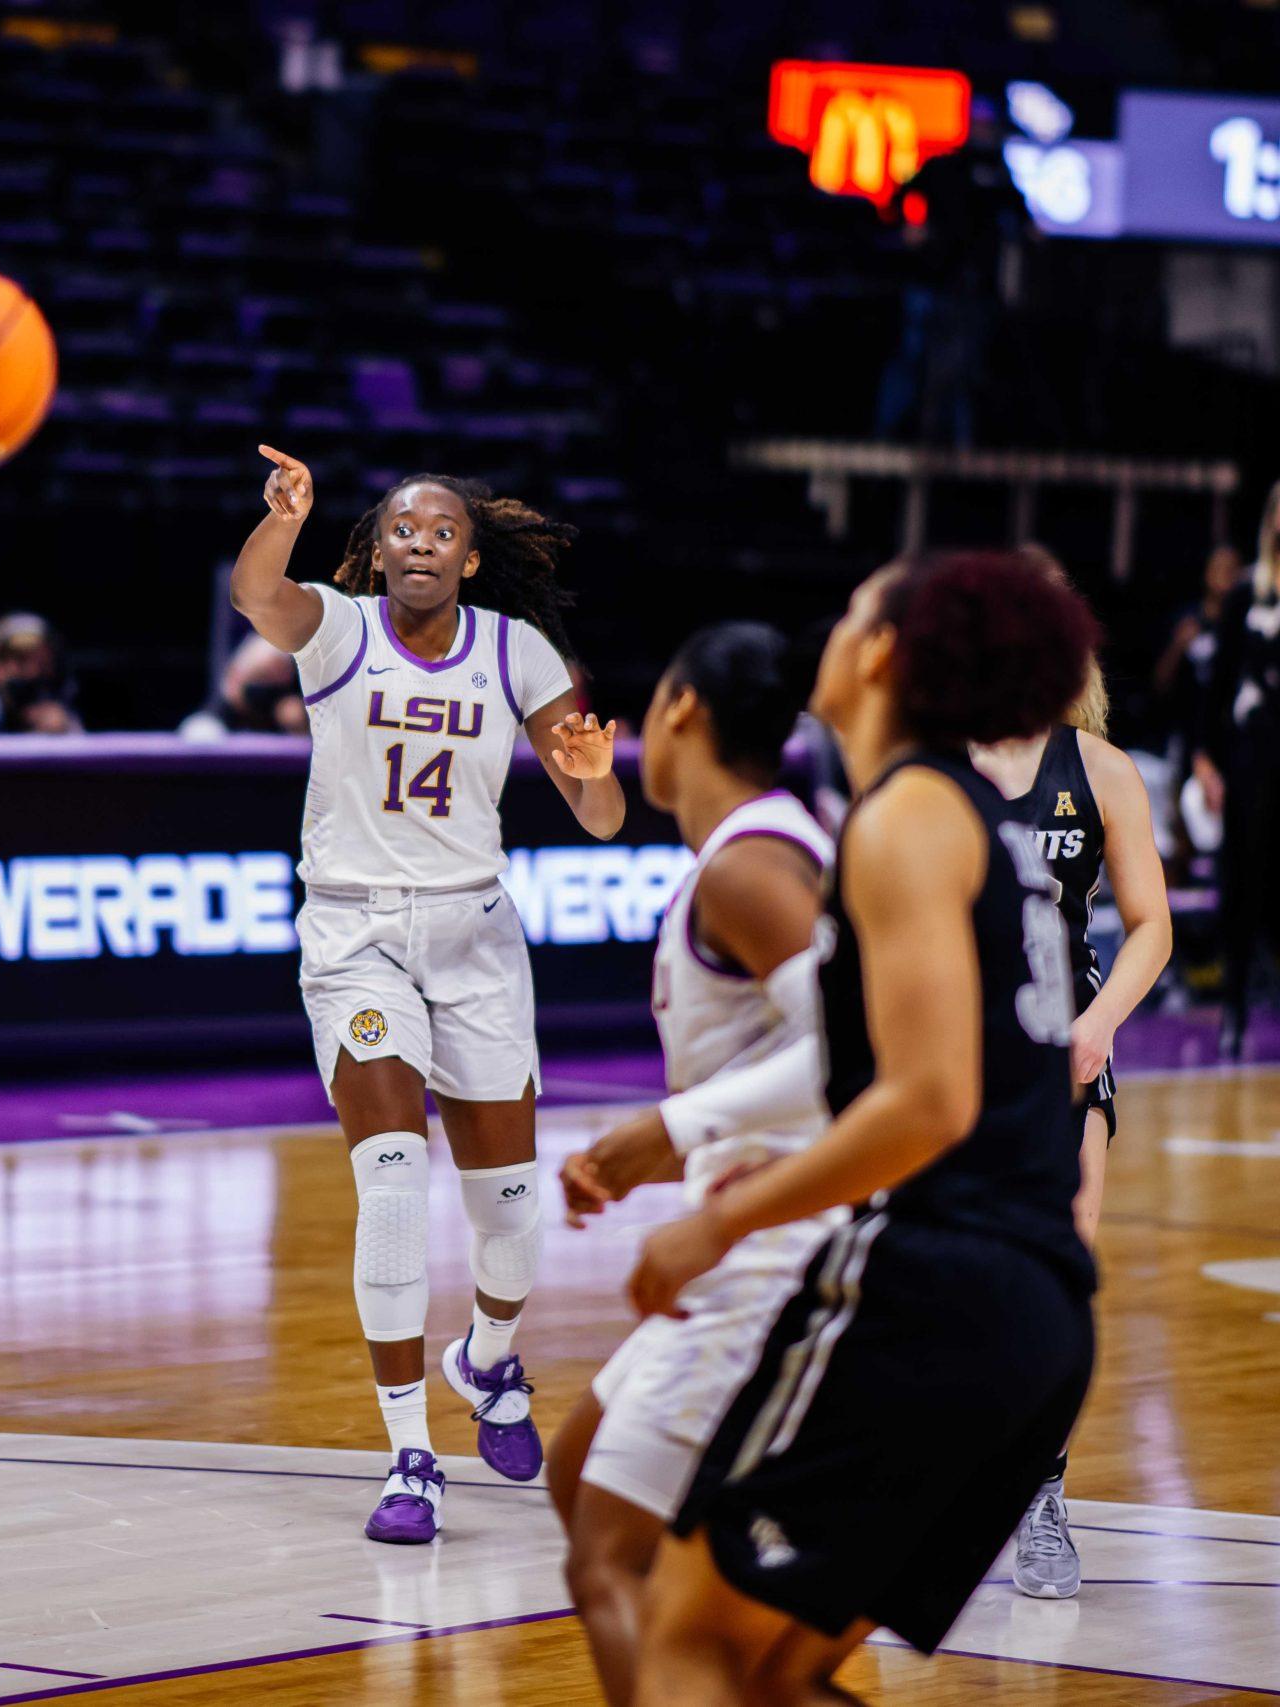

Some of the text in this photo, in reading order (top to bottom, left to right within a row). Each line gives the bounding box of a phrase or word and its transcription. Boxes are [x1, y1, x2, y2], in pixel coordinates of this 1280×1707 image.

[367, 690, 484, 739] LSU
[382, 742, 455, 818] 14
[1054, 791, 1077, 817] A
